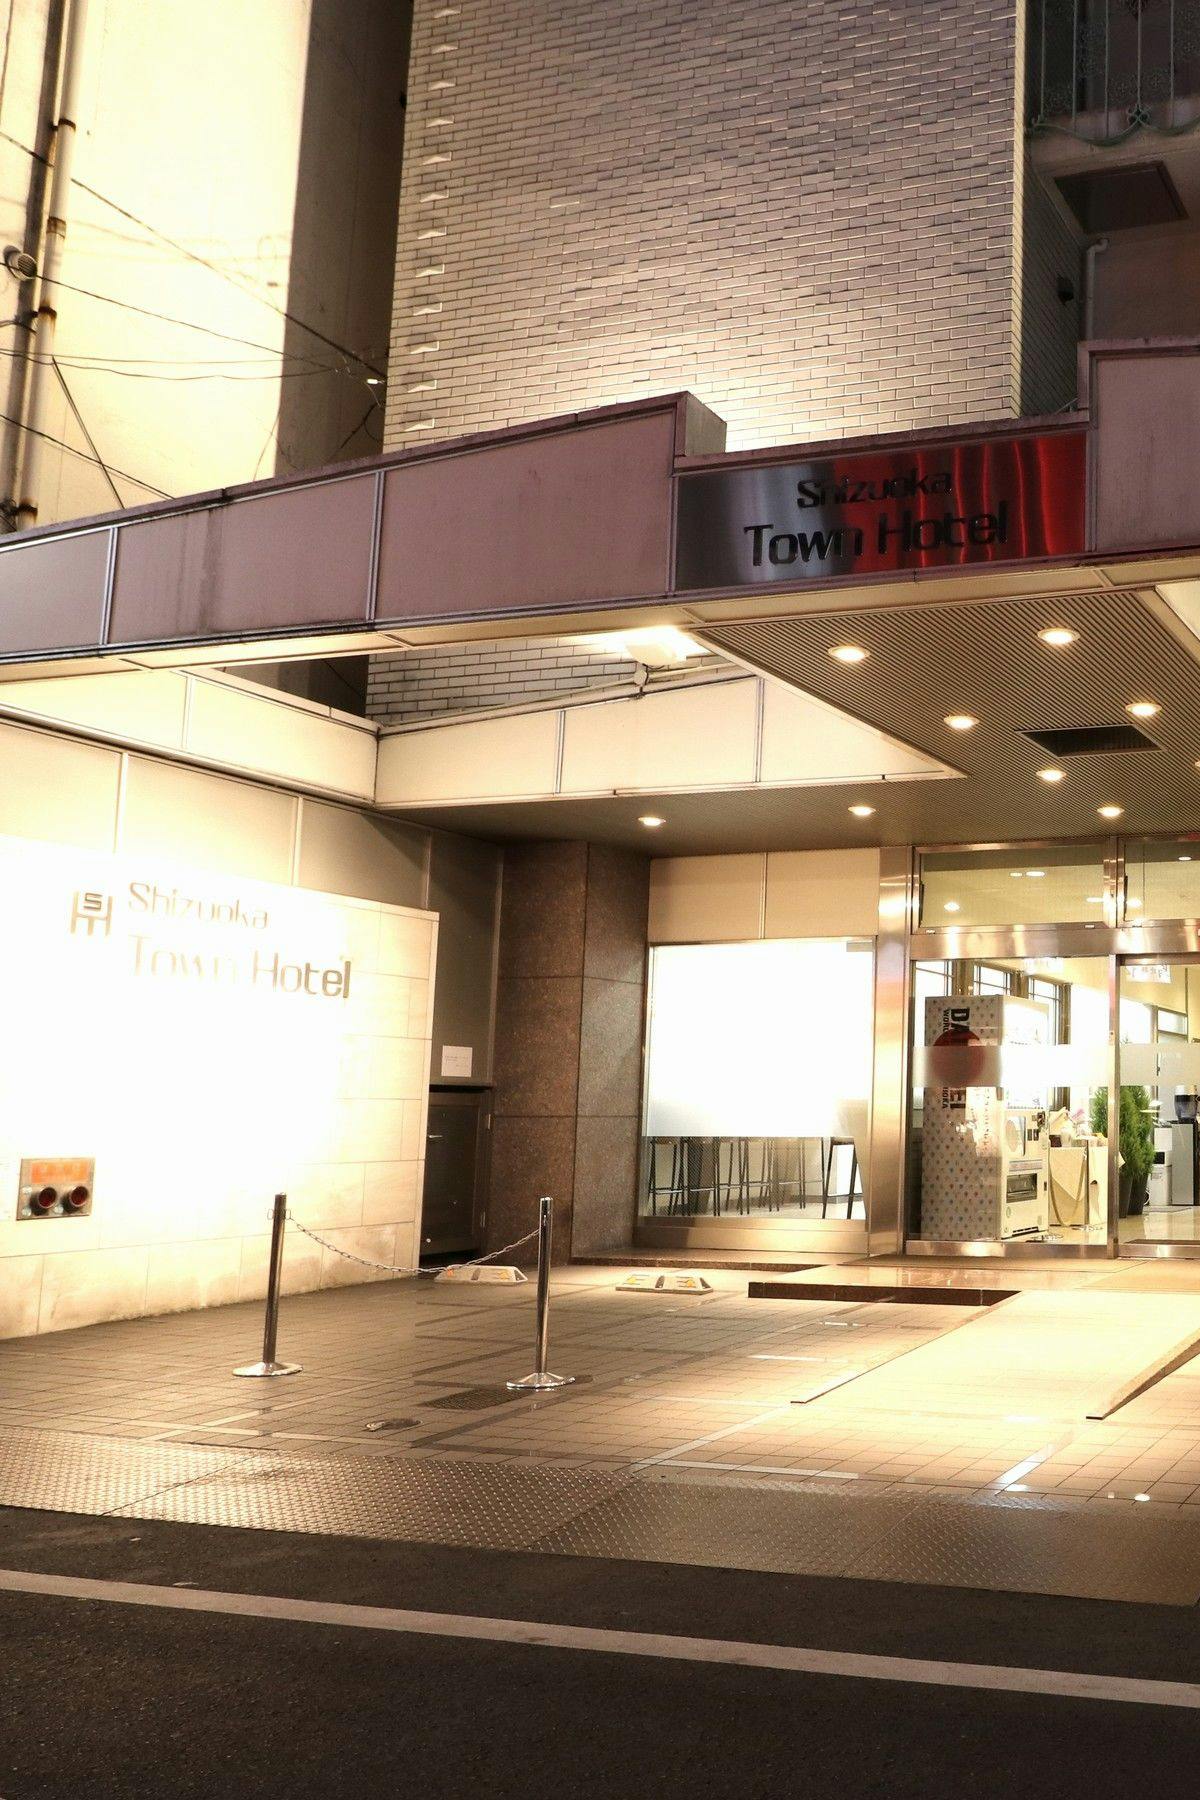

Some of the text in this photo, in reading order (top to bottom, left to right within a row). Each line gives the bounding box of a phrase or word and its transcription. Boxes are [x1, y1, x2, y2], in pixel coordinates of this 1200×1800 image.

[796, 468, 953, 509] Shizuoka
[743, 500, 1009, 567] Town Hotel
[128, 881, 269, 930] Shizuoka
[128, 934, 352, 1000] Town Hotel
